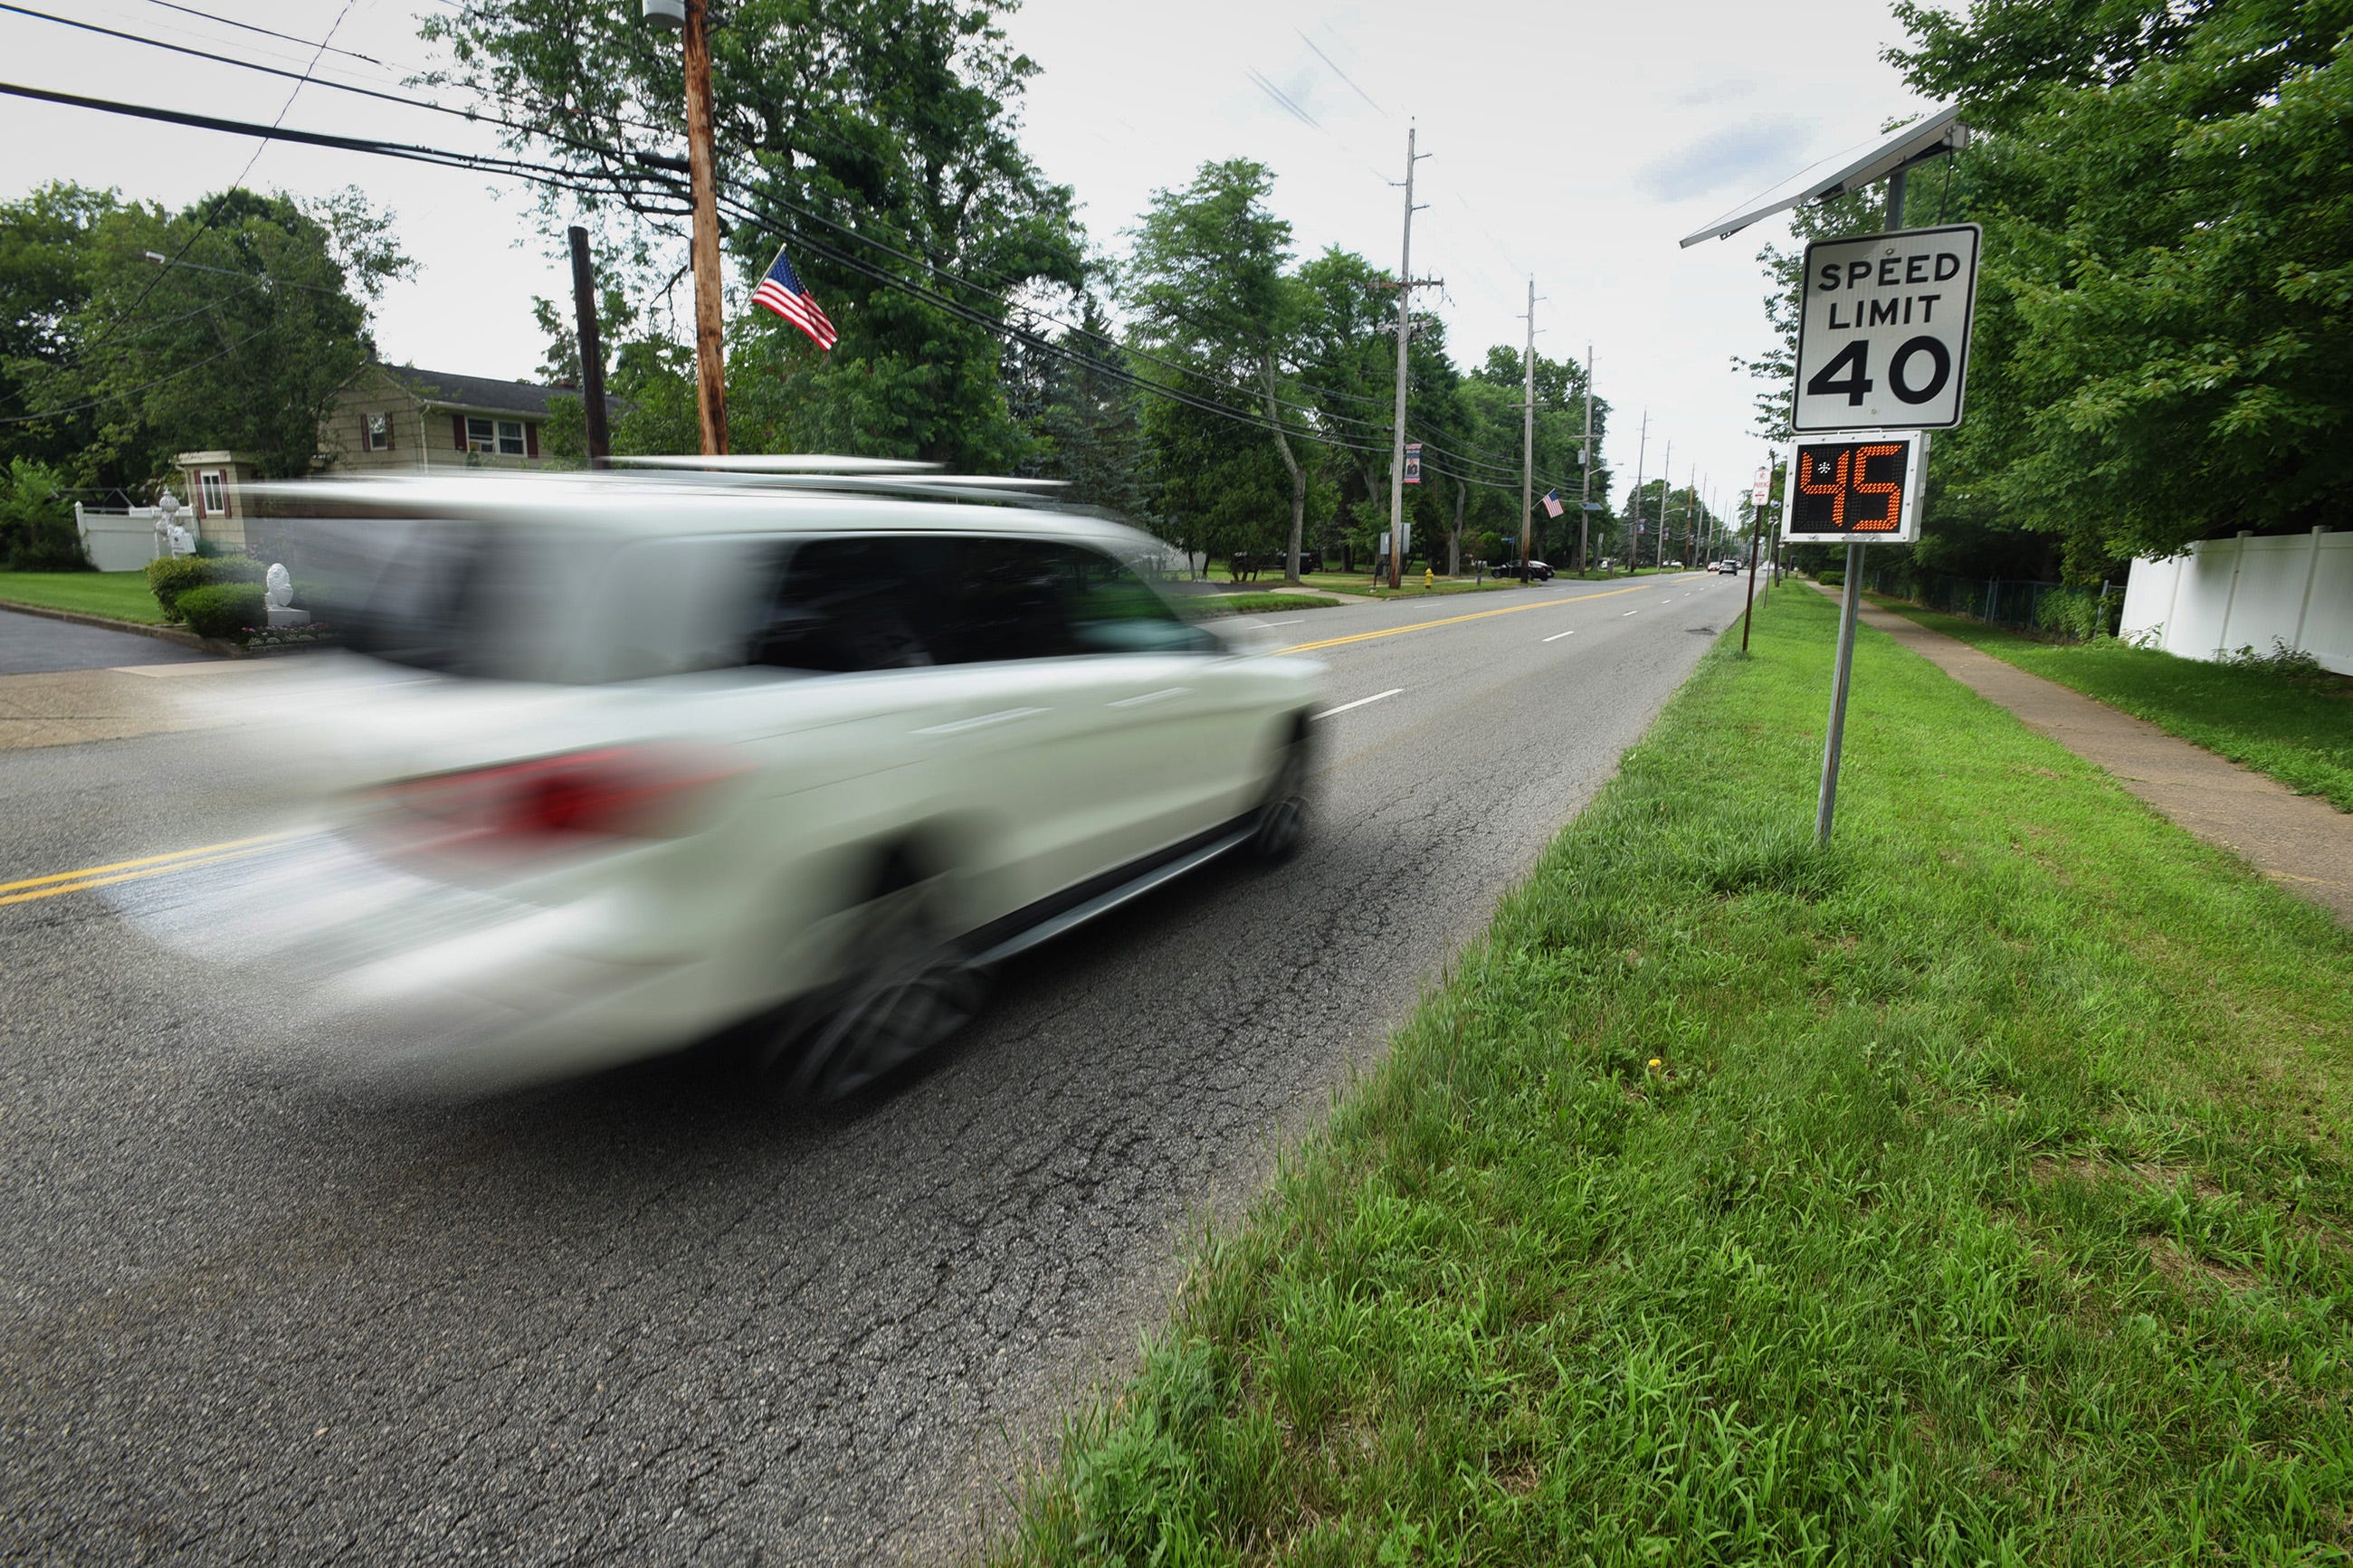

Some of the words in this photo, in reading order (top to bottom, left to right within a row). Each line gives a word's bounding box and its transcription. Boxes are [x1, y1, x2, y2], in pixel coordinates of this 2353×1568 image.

[1817, 252, 1961, 292] SPEED
[1828, 294, 1941, 330] LIMIT
[1806, 335, 1951, 406] 40
[1799, 444, 1903, 531] 45
